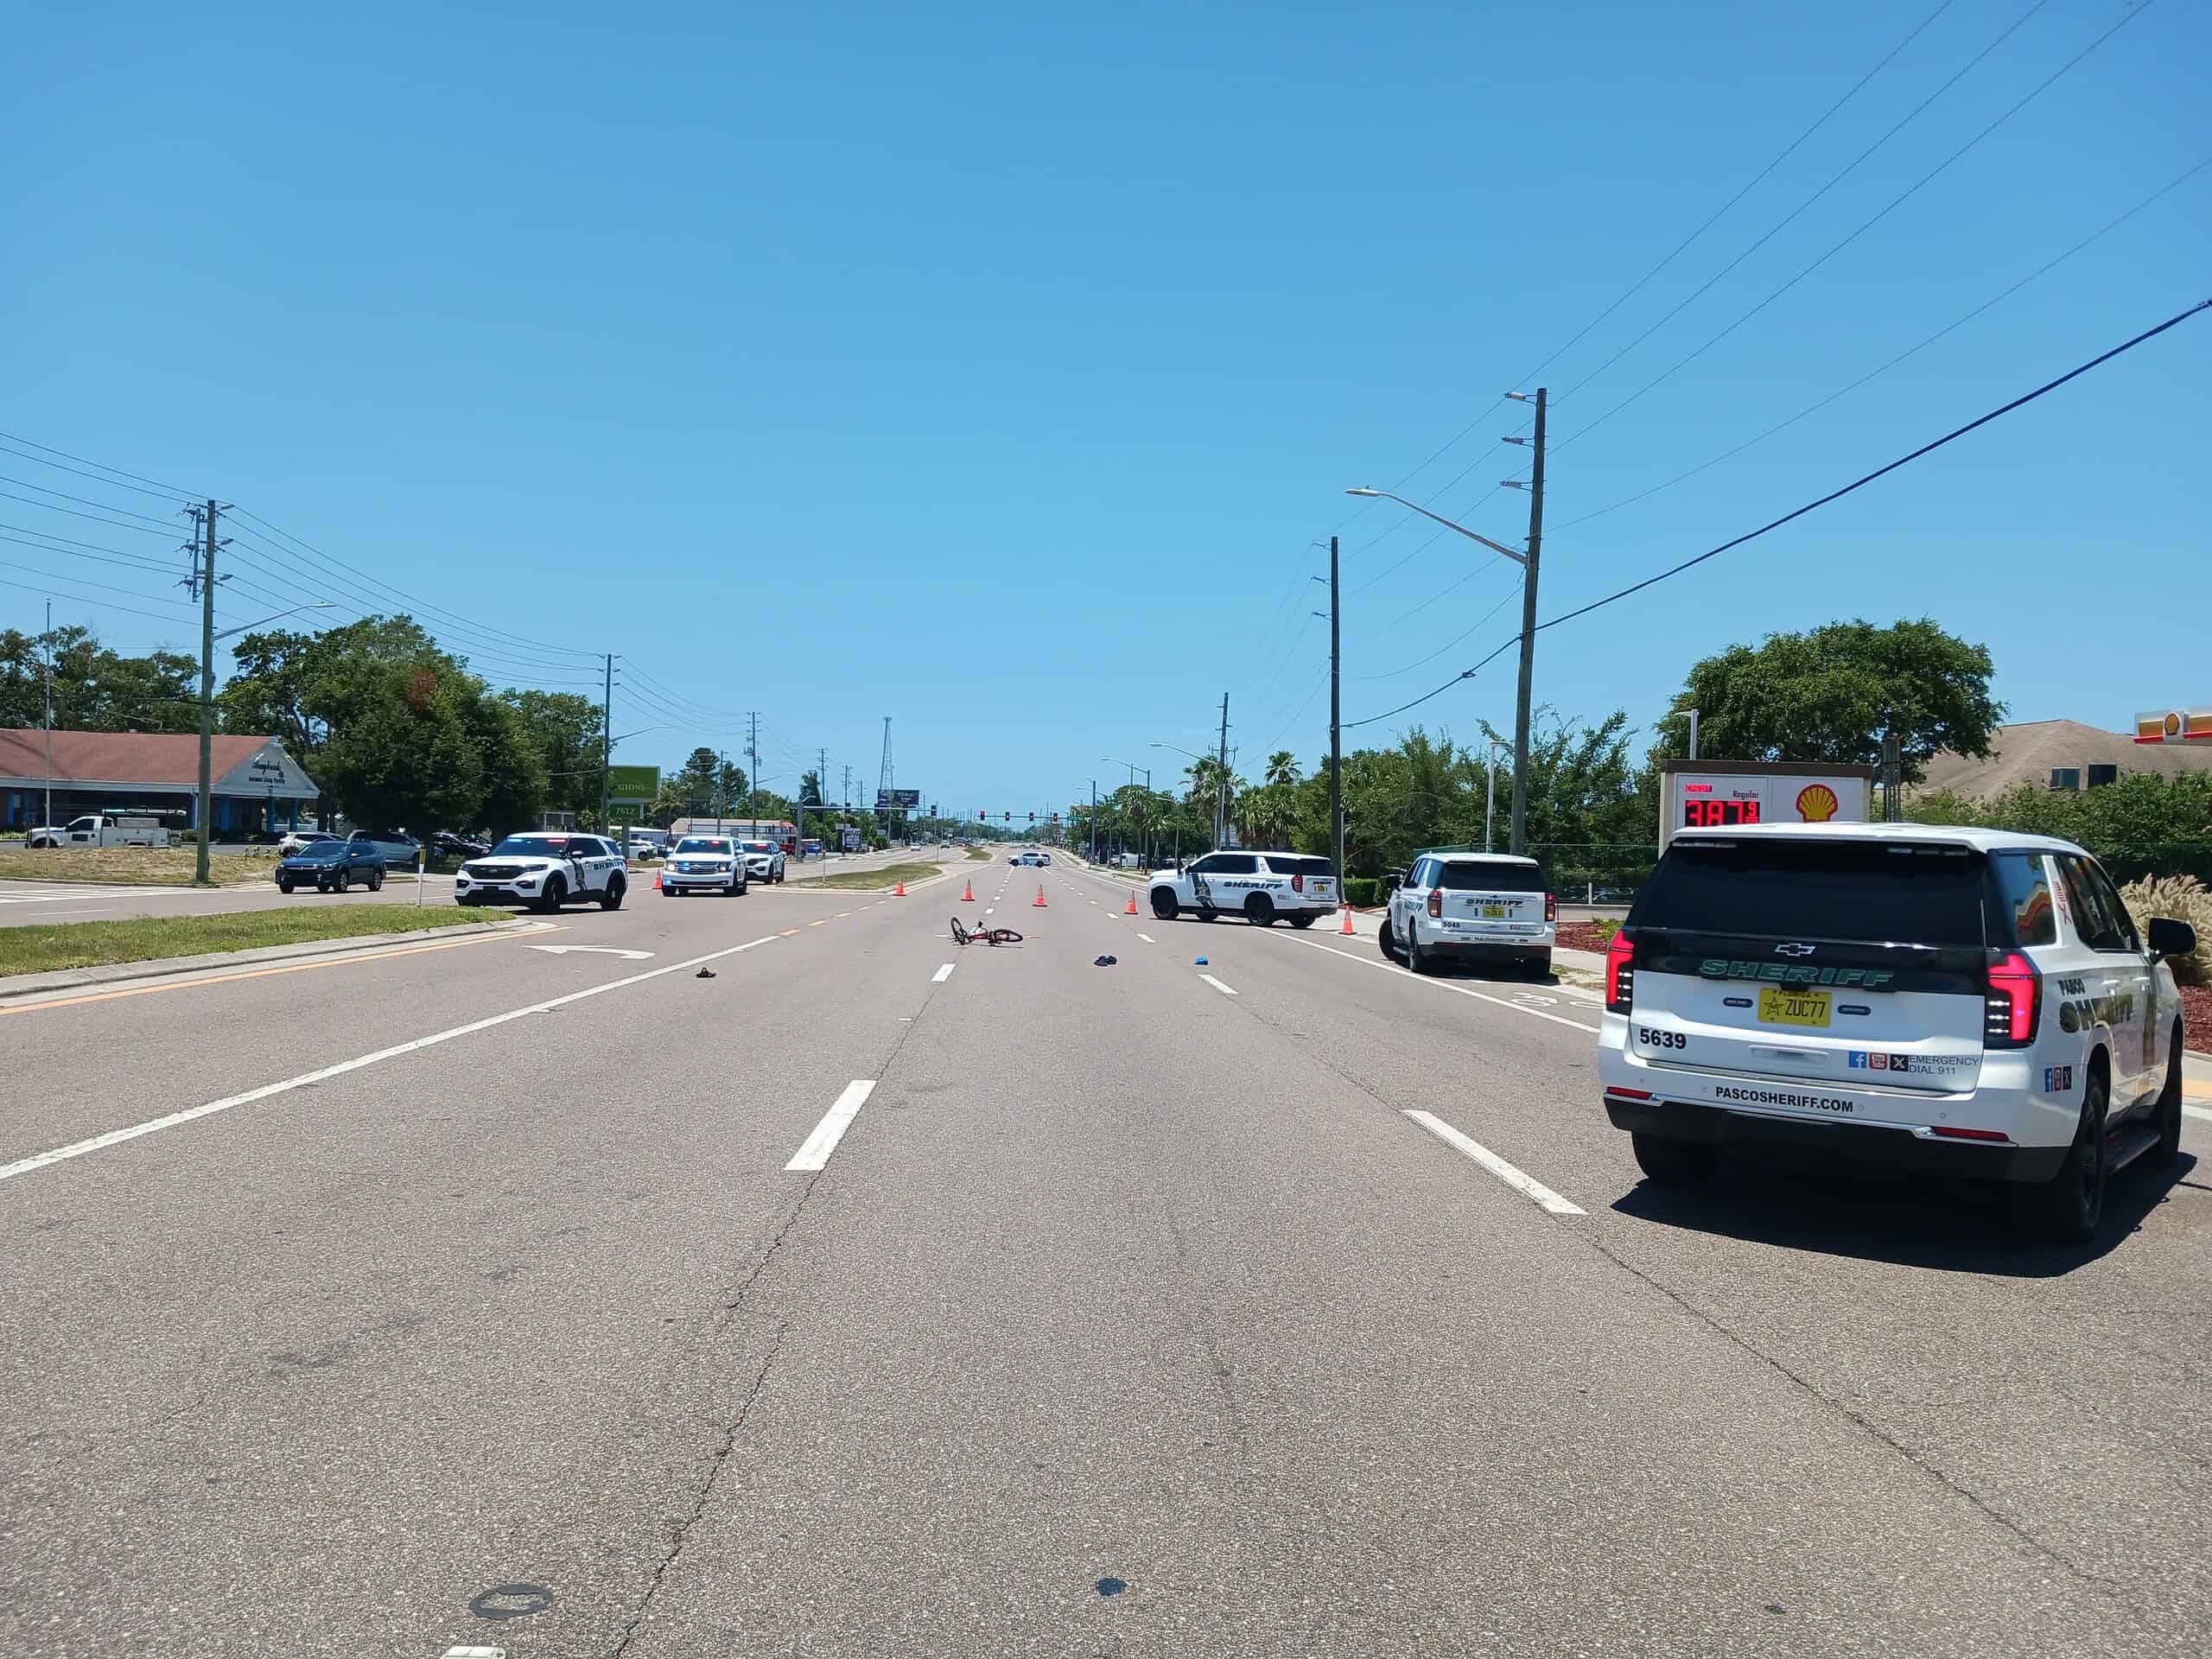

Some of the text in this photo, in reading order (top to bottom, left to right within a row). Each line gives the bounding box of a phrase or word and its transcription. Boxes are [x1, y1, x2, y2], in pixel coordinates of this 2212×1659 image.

[1732, 790, 1759, 800] Regular
[1223, 880, 1284, 889] SHERIFF
[1700, 959, 1895, 987] SHERIFF
[1785, 998, 1826, 1018] ZUC77
[1639, 1028, 1687, 1050] 5639
[1908, 1056, 1979, 1066] EMERGENCY
[1909, 1065, 1956, 1075] DIAL 911
[1715, 1086, 1853, 1113] PASCOSHERIFF.COM
